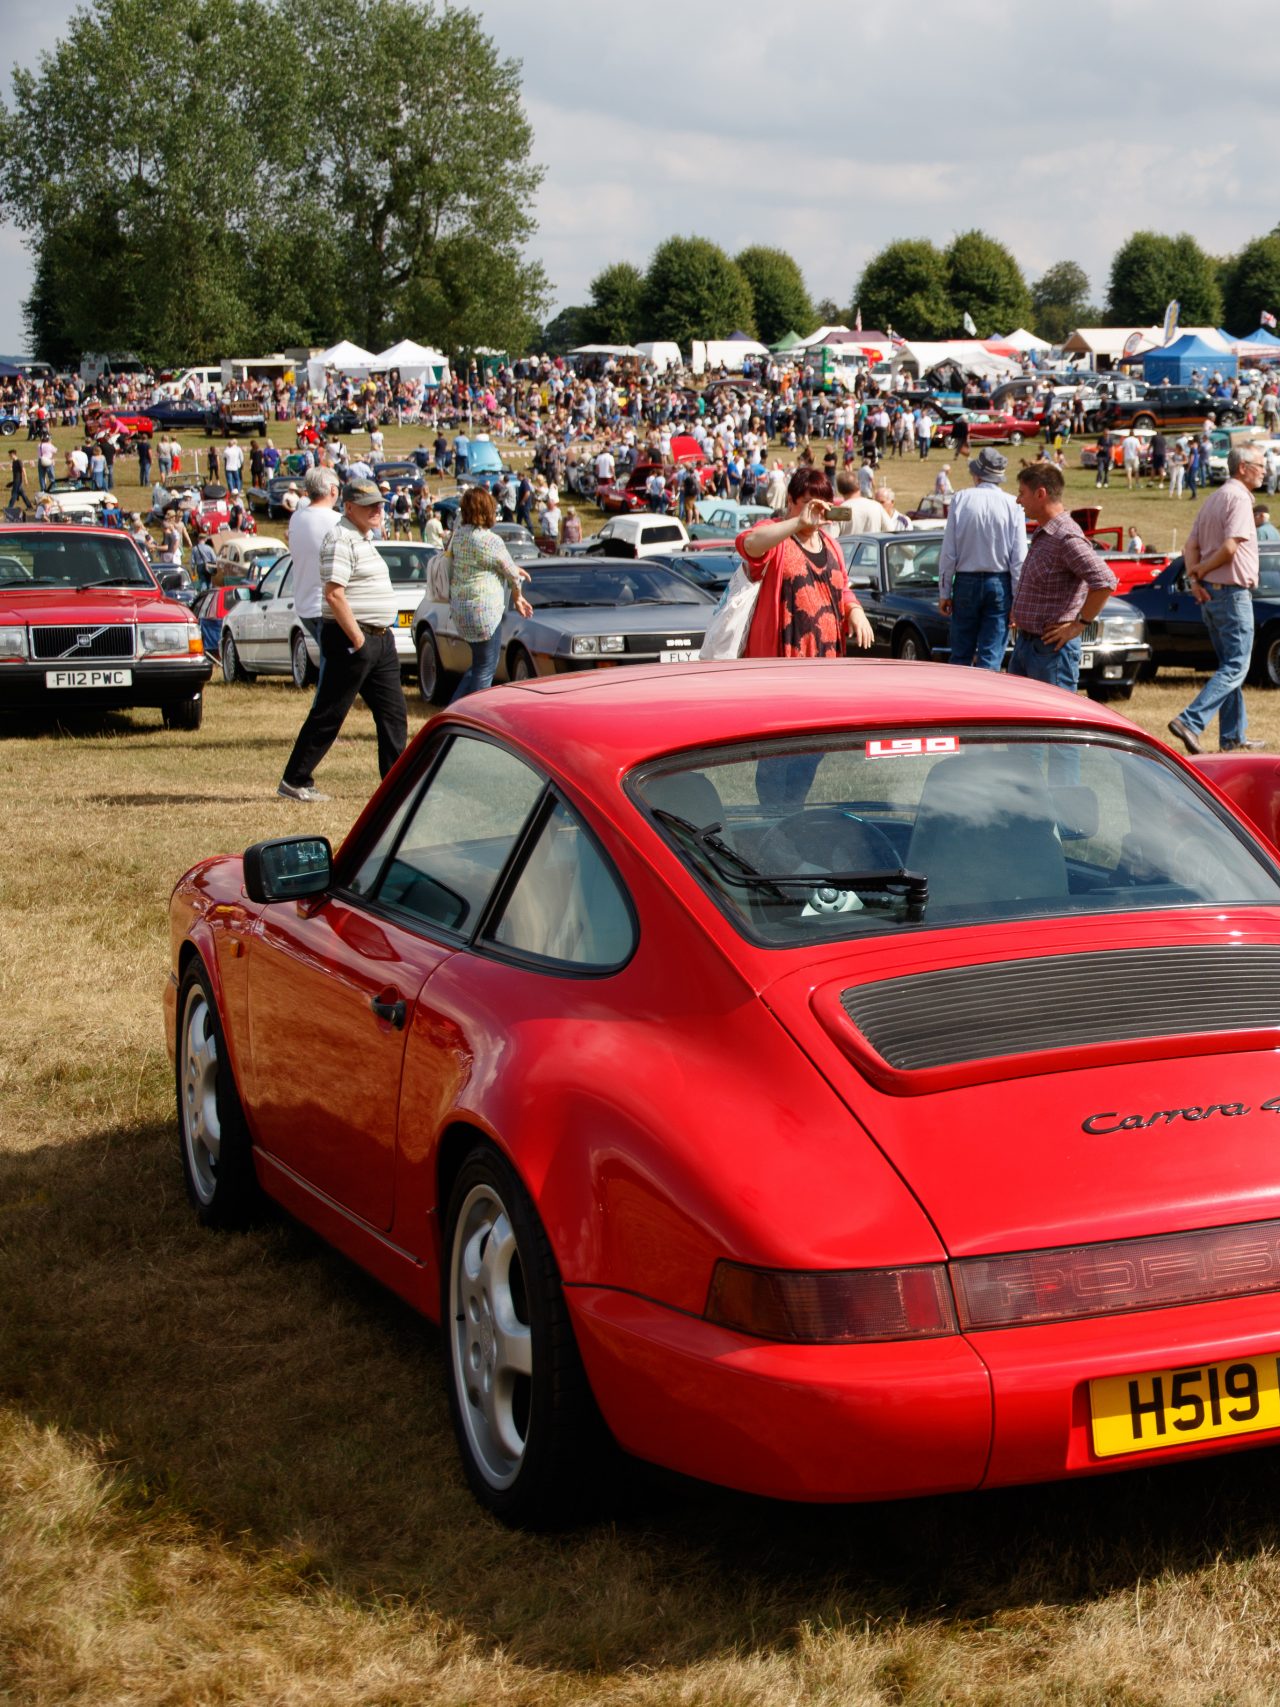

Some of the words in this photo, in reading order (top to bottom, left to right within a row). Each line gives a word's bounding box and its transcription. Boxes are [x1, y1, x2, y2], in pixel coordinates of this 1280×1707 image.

[56, 672, 87, 686] F112
[91, 671, 124, 685] PWC
[1081, 1102, 1252, 1136] Carrera
[1128, 1362, 1260, 1440] H519
